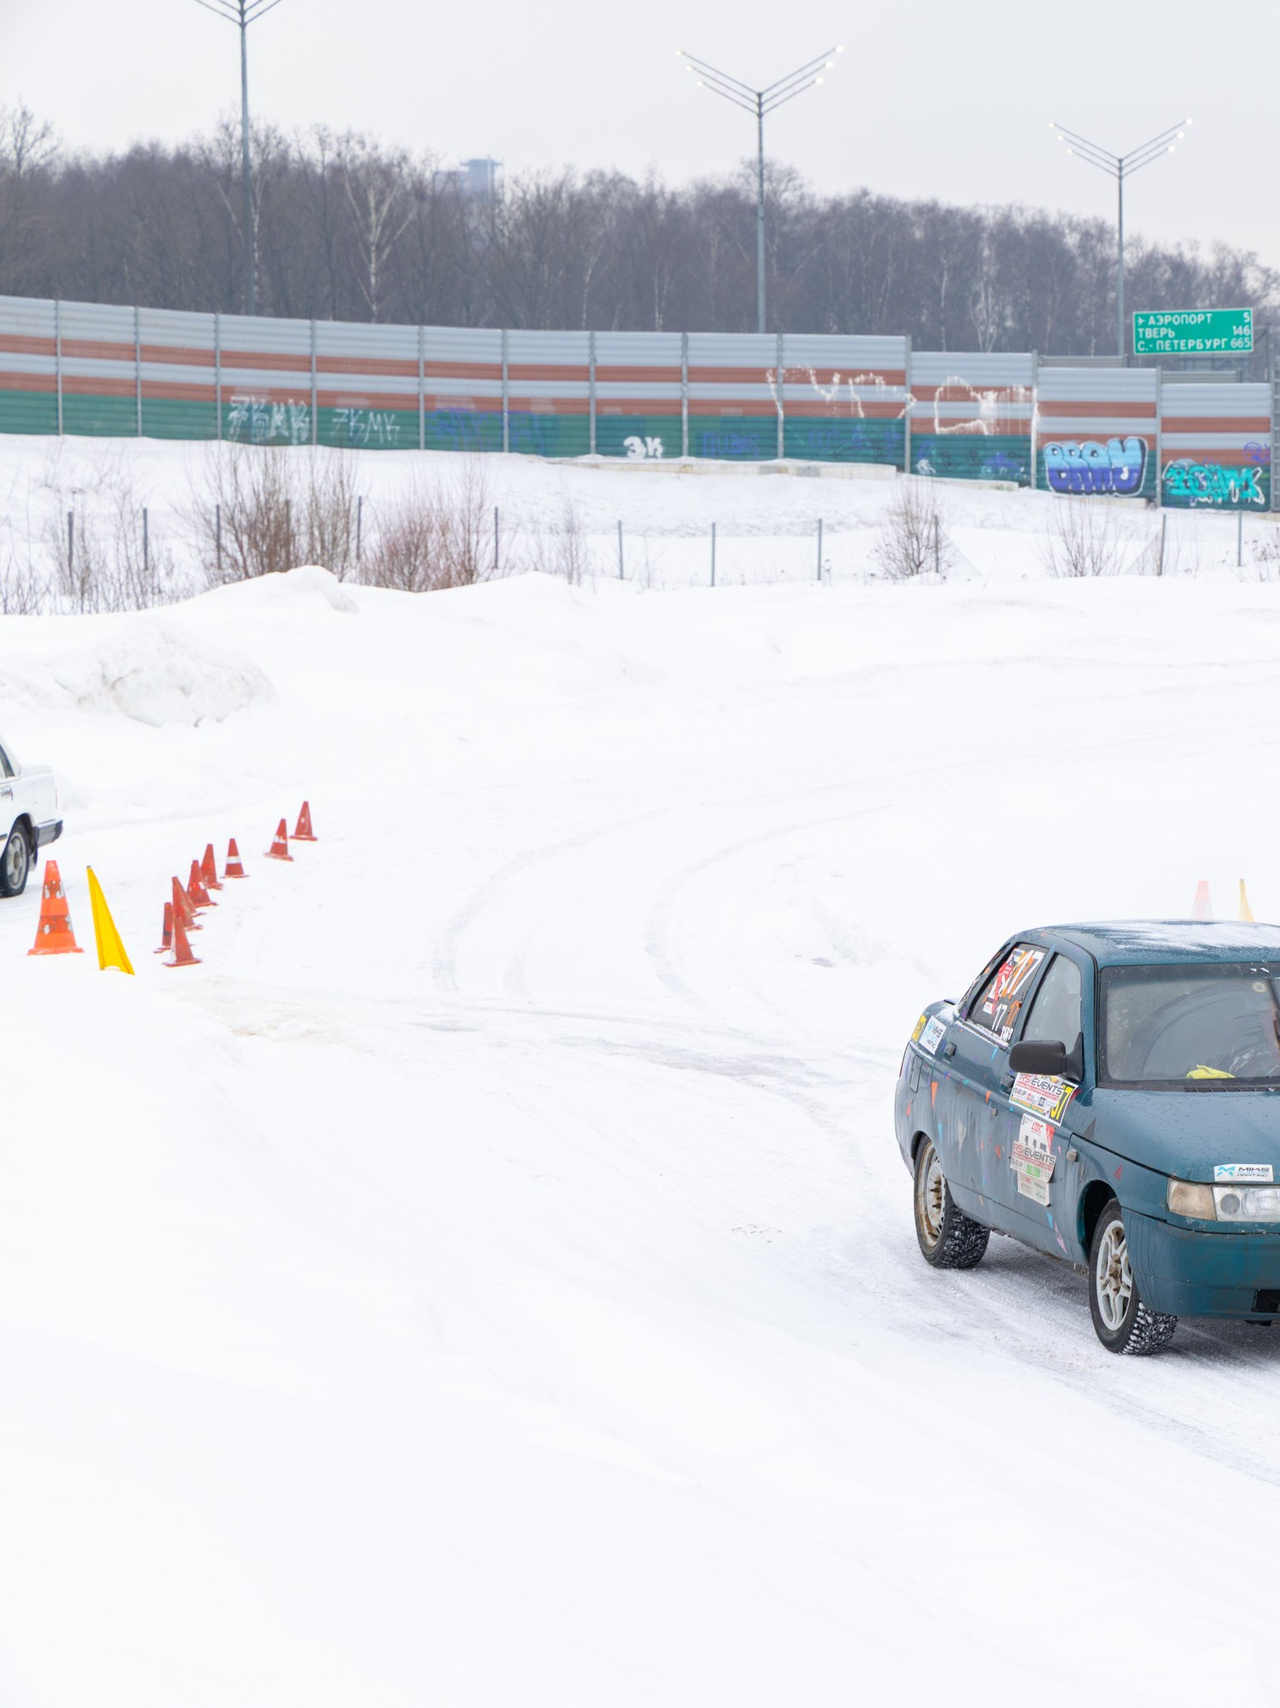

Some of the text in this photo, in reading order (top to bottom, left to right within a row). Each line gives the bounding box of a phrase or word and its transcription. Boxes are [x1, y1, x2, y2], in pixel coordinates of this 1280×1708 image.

[1148, 311, 1251, 326] АЭРОПОРТ 5
[1137, 325, 1251, 339] ТВЕРЬ 146
[1230, 337, 1251, 349] 665
[1031, 1077, 1063, 1096] EVENTS
[1024, 1147, 1056, 1166] EVENTS
